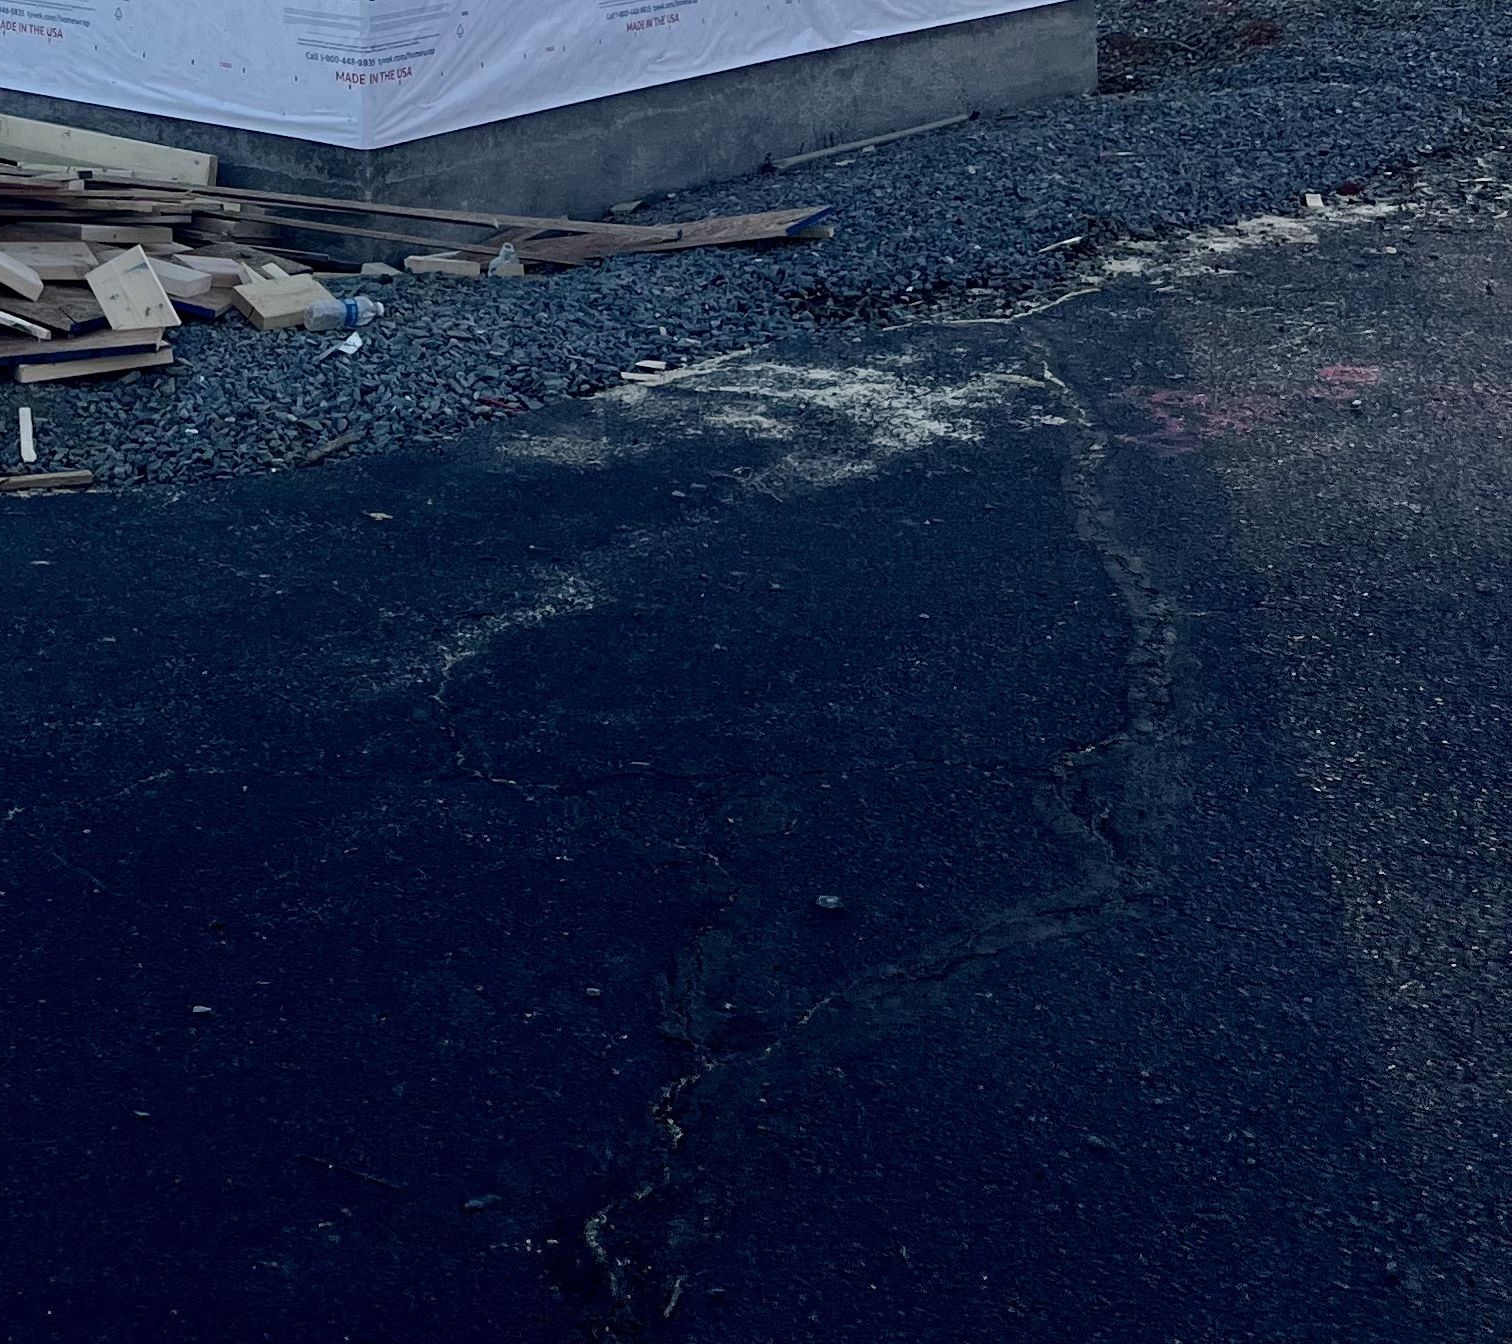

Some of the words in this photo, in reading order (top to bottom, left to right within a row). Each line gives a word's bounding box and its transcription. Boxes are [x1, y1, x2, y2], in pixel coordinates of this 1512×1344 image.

[336, 72, 365, 84] MADE
[370, 74, 378, 84] IN
[380, 69, 396, 82] THE
[397, 66, 412, 78] USA
